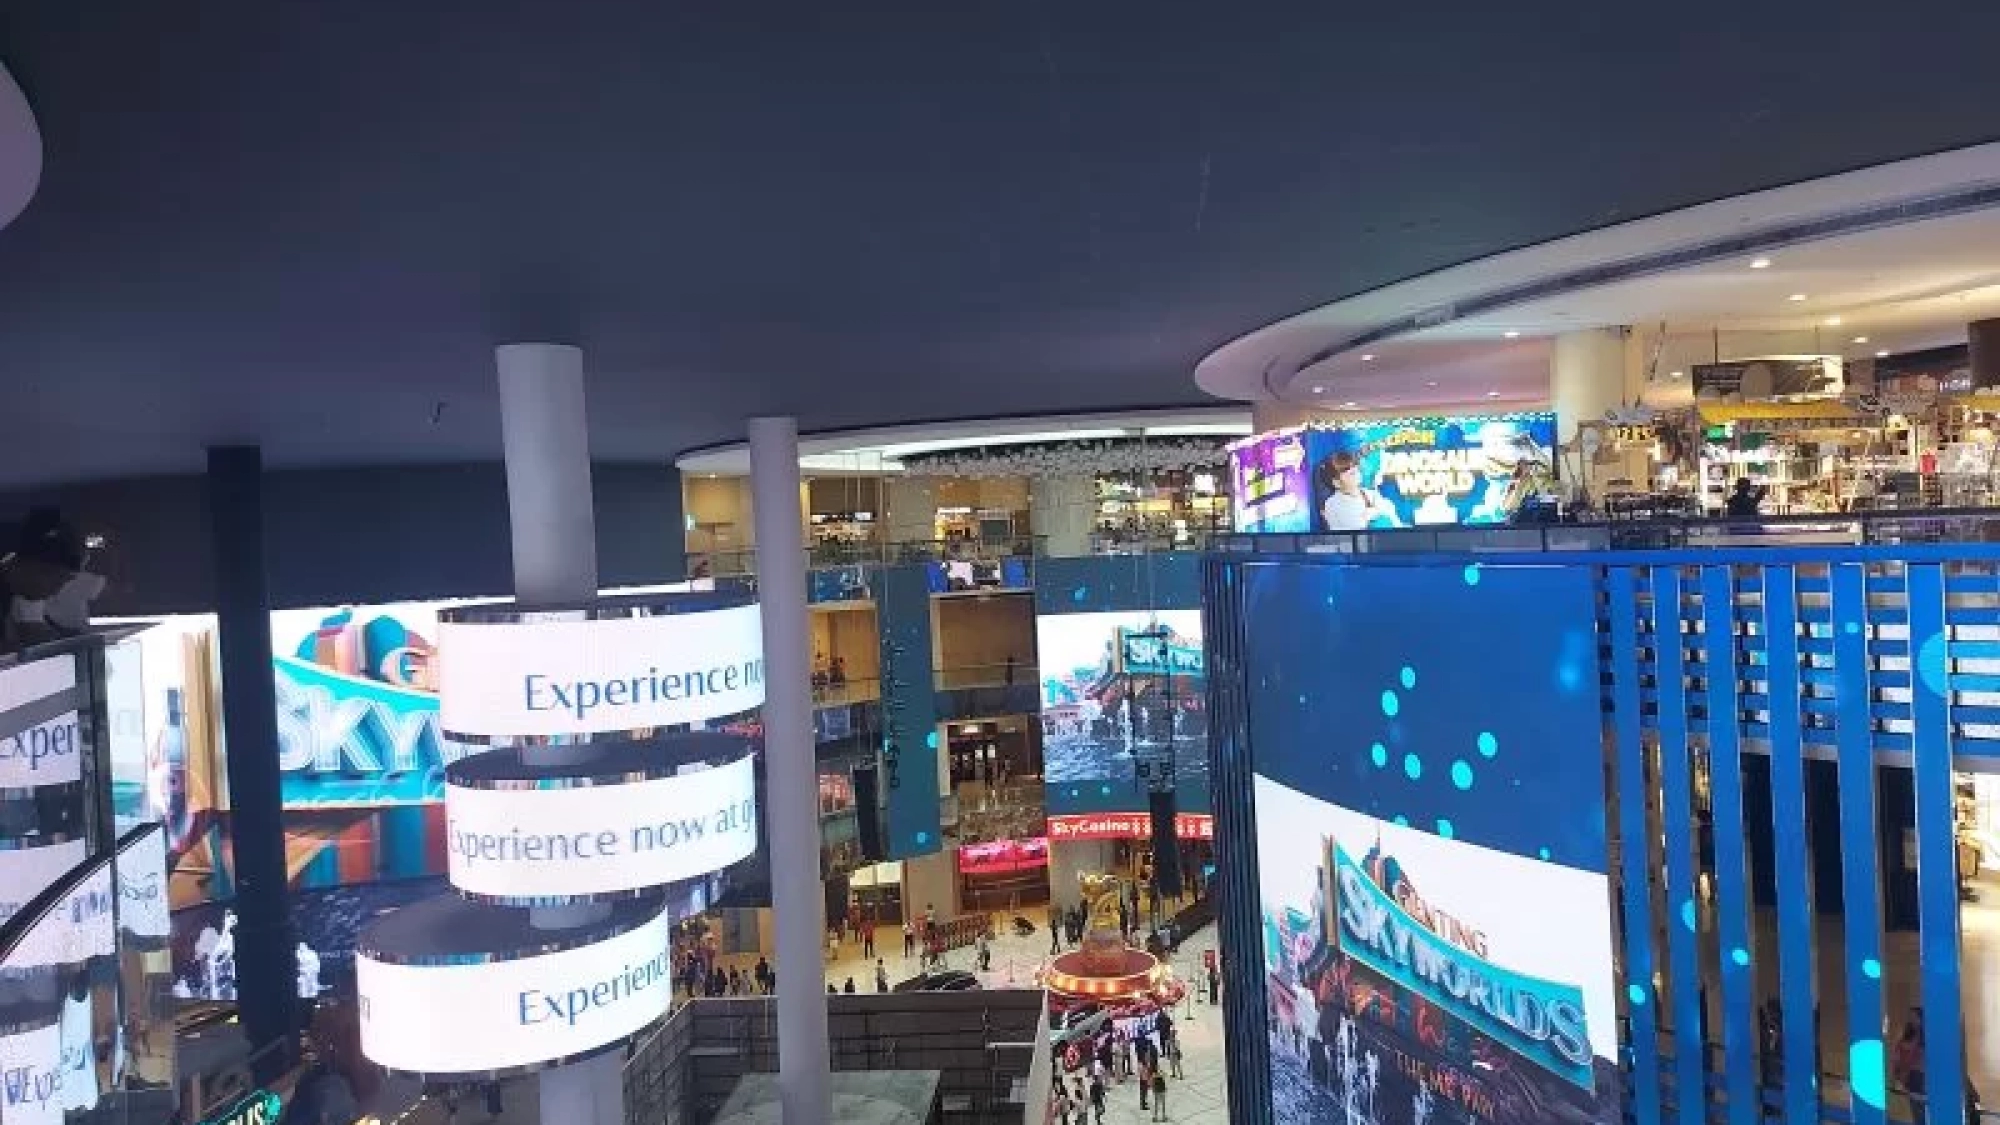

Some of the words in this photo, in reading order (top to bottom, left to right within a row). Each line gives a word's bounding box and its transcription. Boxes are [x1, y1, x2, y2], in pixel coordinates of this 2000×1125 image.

[1398, 470, 1474, 496] WORLD
[525, 664, 738, 720] Experience
[630, 814, 707, 853] now
[1051, 819, 1130, 838] SkyCasino
[1392, 878, 1489, 958] GENTING
[1338, 863, 1593, 1068] SKYWORLDS
